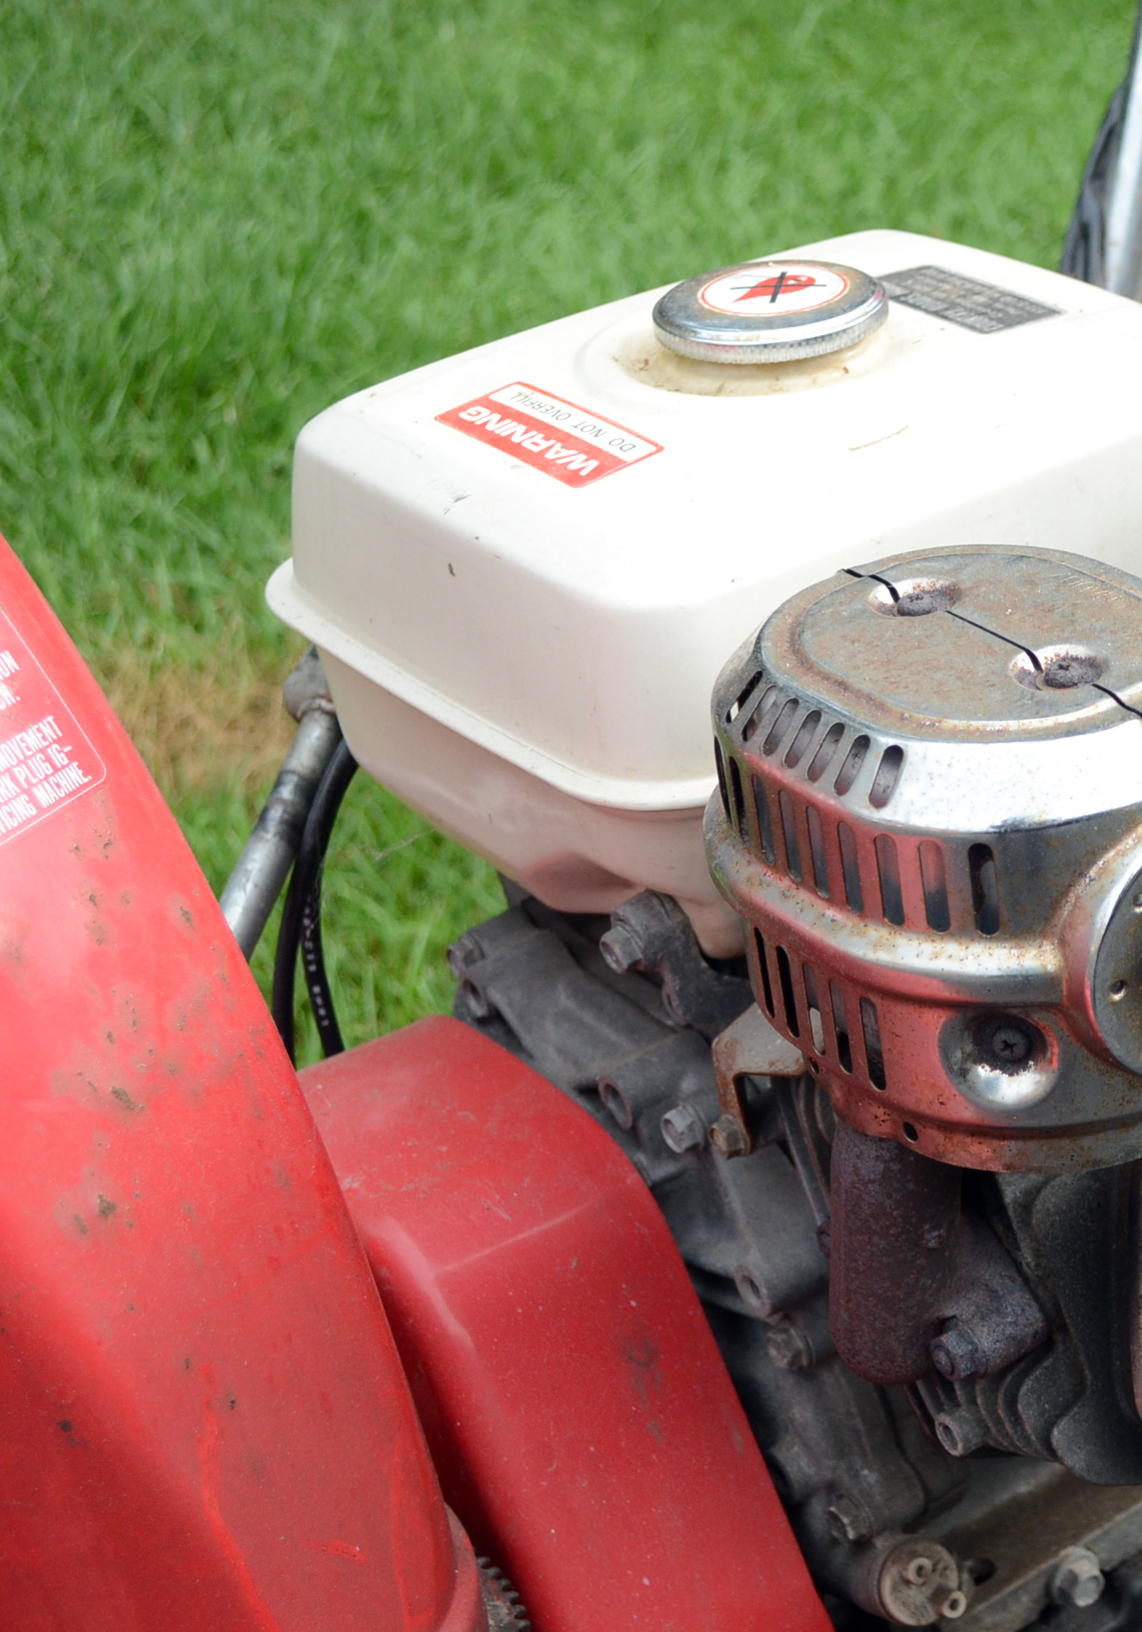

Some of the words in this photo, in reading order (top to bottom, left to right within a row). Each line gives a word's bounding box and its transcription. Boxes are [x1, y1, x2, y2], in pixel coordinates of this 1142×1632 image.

[510, 391, 572, 421] OVERFILL
[458, 405, 600, 477] WARNING
[570, 420, 609, 438] NOT
[608, 437, 637, 453] DO
[13, 752, 54, 789] PLUG
[32, 761, 93, 808] MACHINE.
